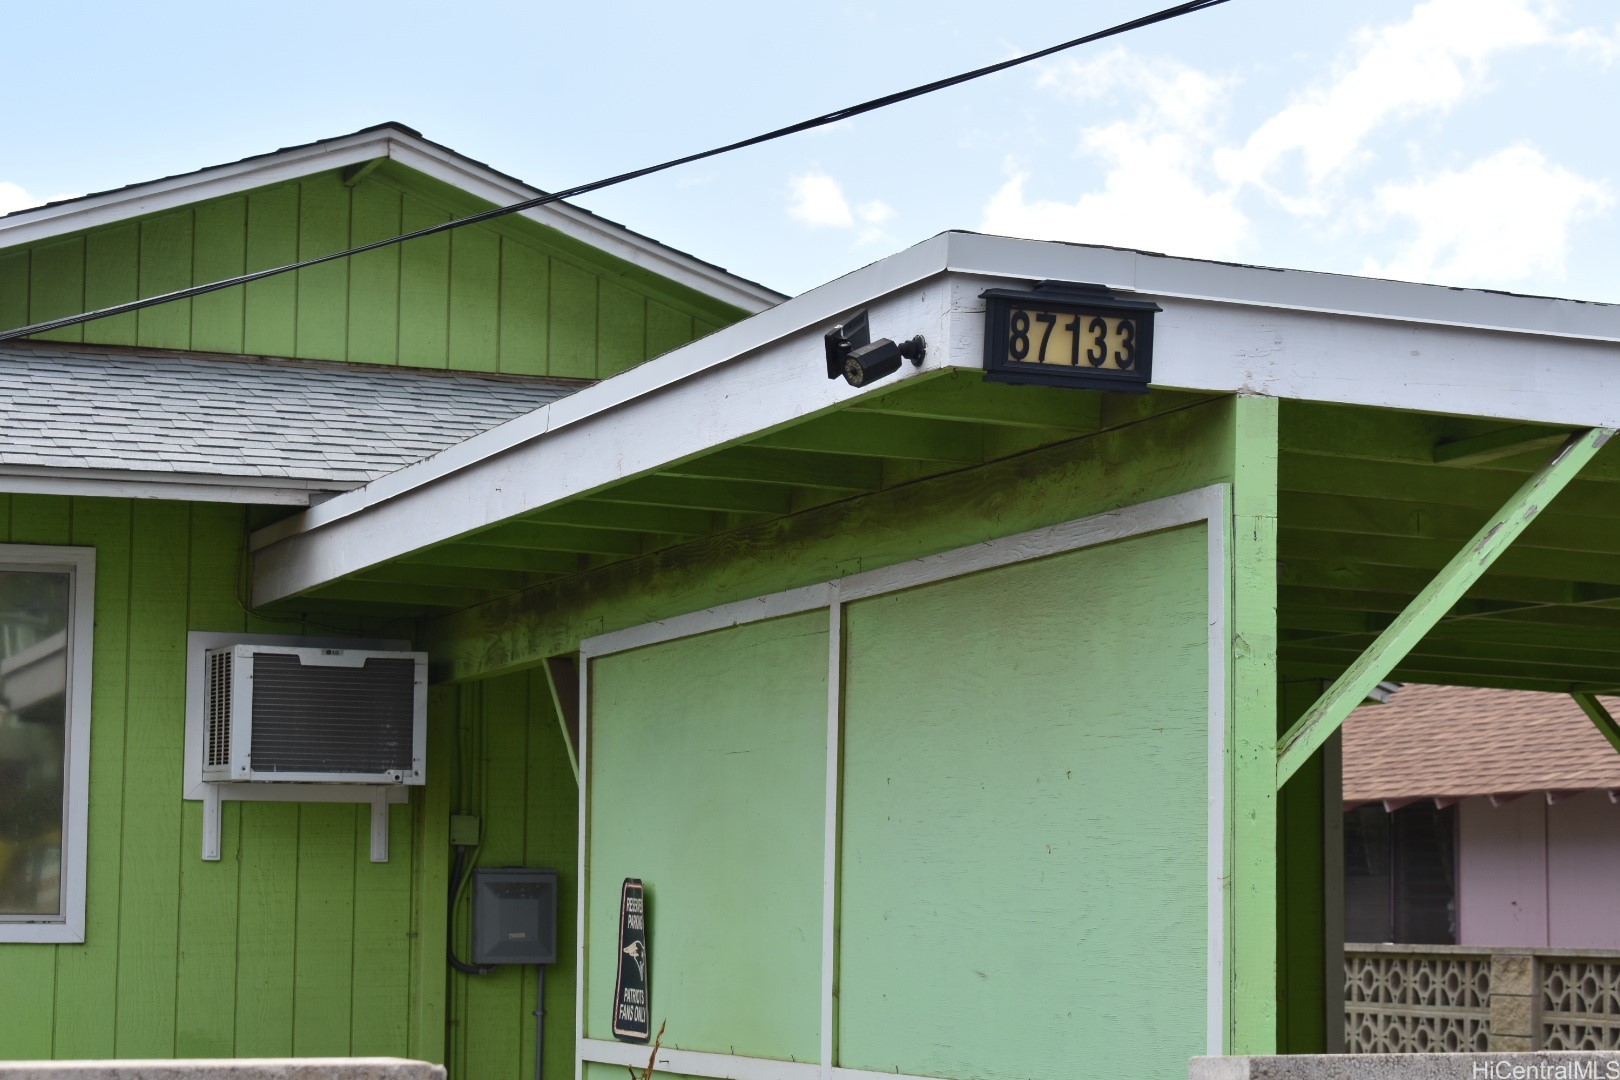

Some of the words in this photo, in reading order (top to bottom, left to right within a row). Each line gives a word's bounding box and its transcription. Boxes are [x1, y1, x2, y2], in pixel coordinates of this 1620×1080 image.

[1009, 310, 1135, 370] 87133
[626, 897, 643, 913] RESERVED
[627, 914, 643, 930] PARKING
[623, 987, 645, 1005] PATRIOTS
[618, 1003, 634, 1021] FANS
[634, 1005, 646, 1023] ONLY
